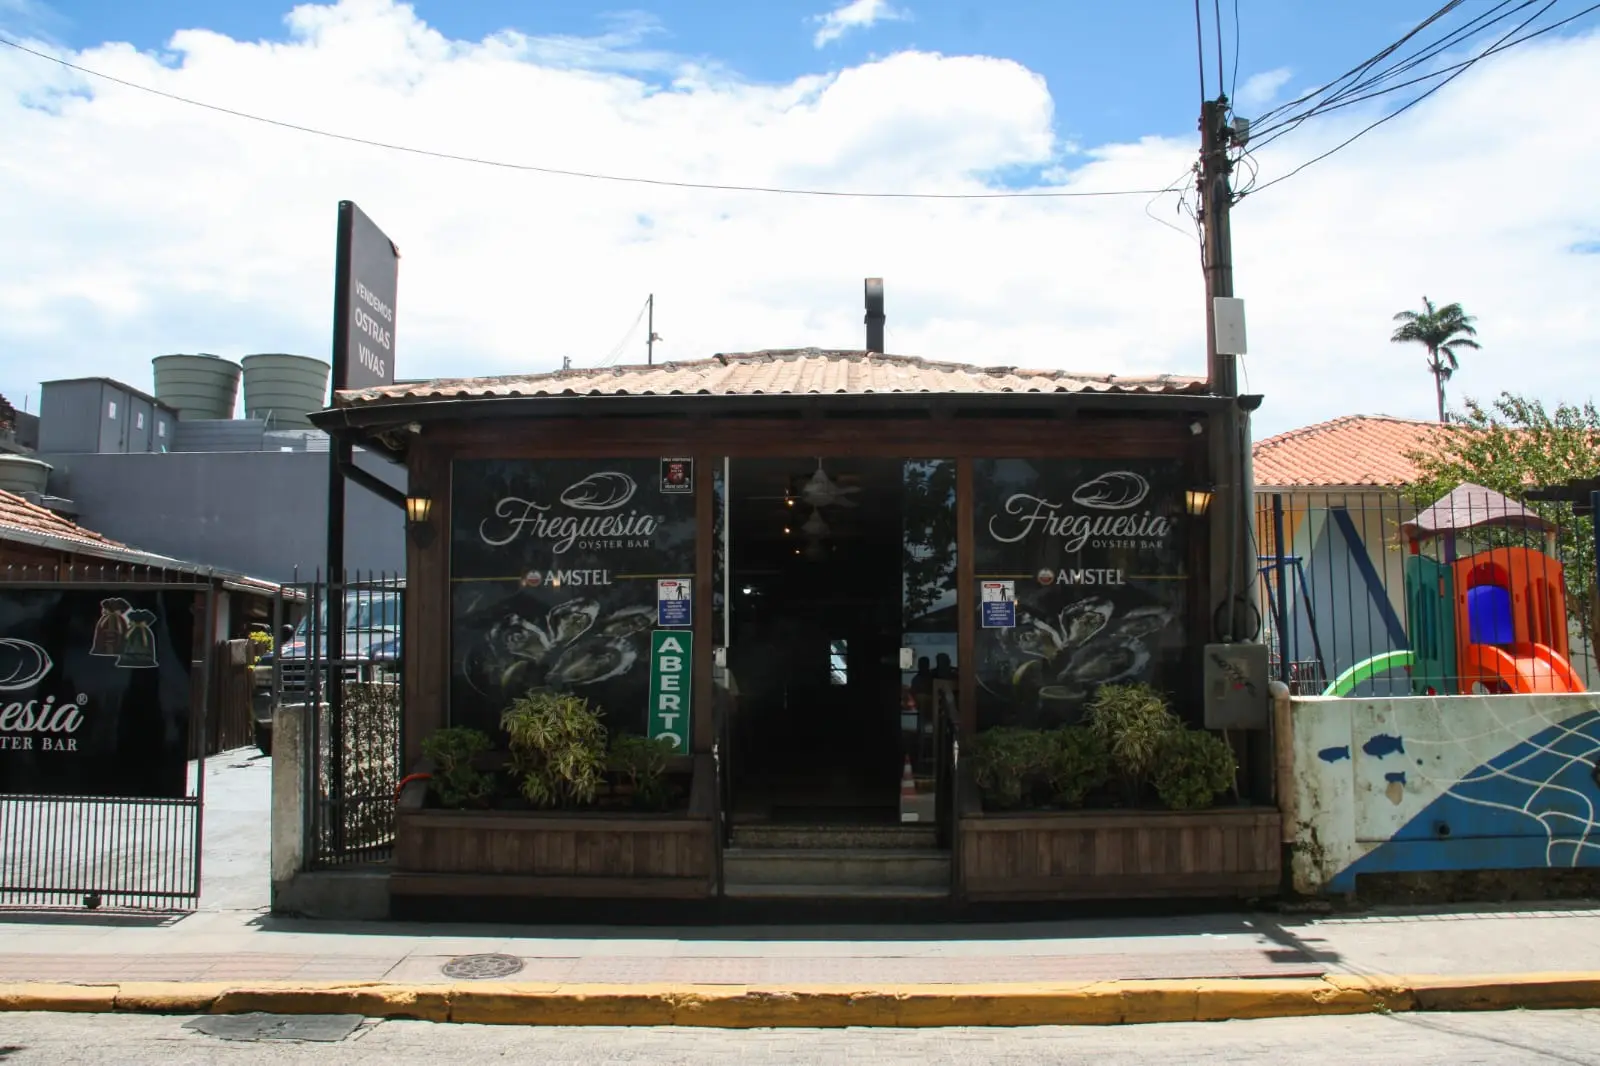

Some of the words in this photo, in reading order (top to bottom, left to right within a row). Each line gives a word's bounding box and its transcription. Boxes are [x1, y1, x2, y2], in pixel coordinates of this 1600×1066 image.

[355, 279, 392, 322] VENDEMOS
[355, 308, 391, 350] OSTRAS
[358, 342, 385, 378] VIVAS
[479, 497, 659, 554] Freguesia
[988, 493, 1170, 553] Freguesia
[578, 540, 623, 550] OYSTER
[627, 538, 650, 548] BAR
[1091, 540, 1136, 549] OYSTER
[1140, 540, 1163, 549] BAR
[543, 569, 612, 586] AMSTEL
[1056, 568, 1125, 585] AMSTEL
[42, 737, 77, 751] BAR
